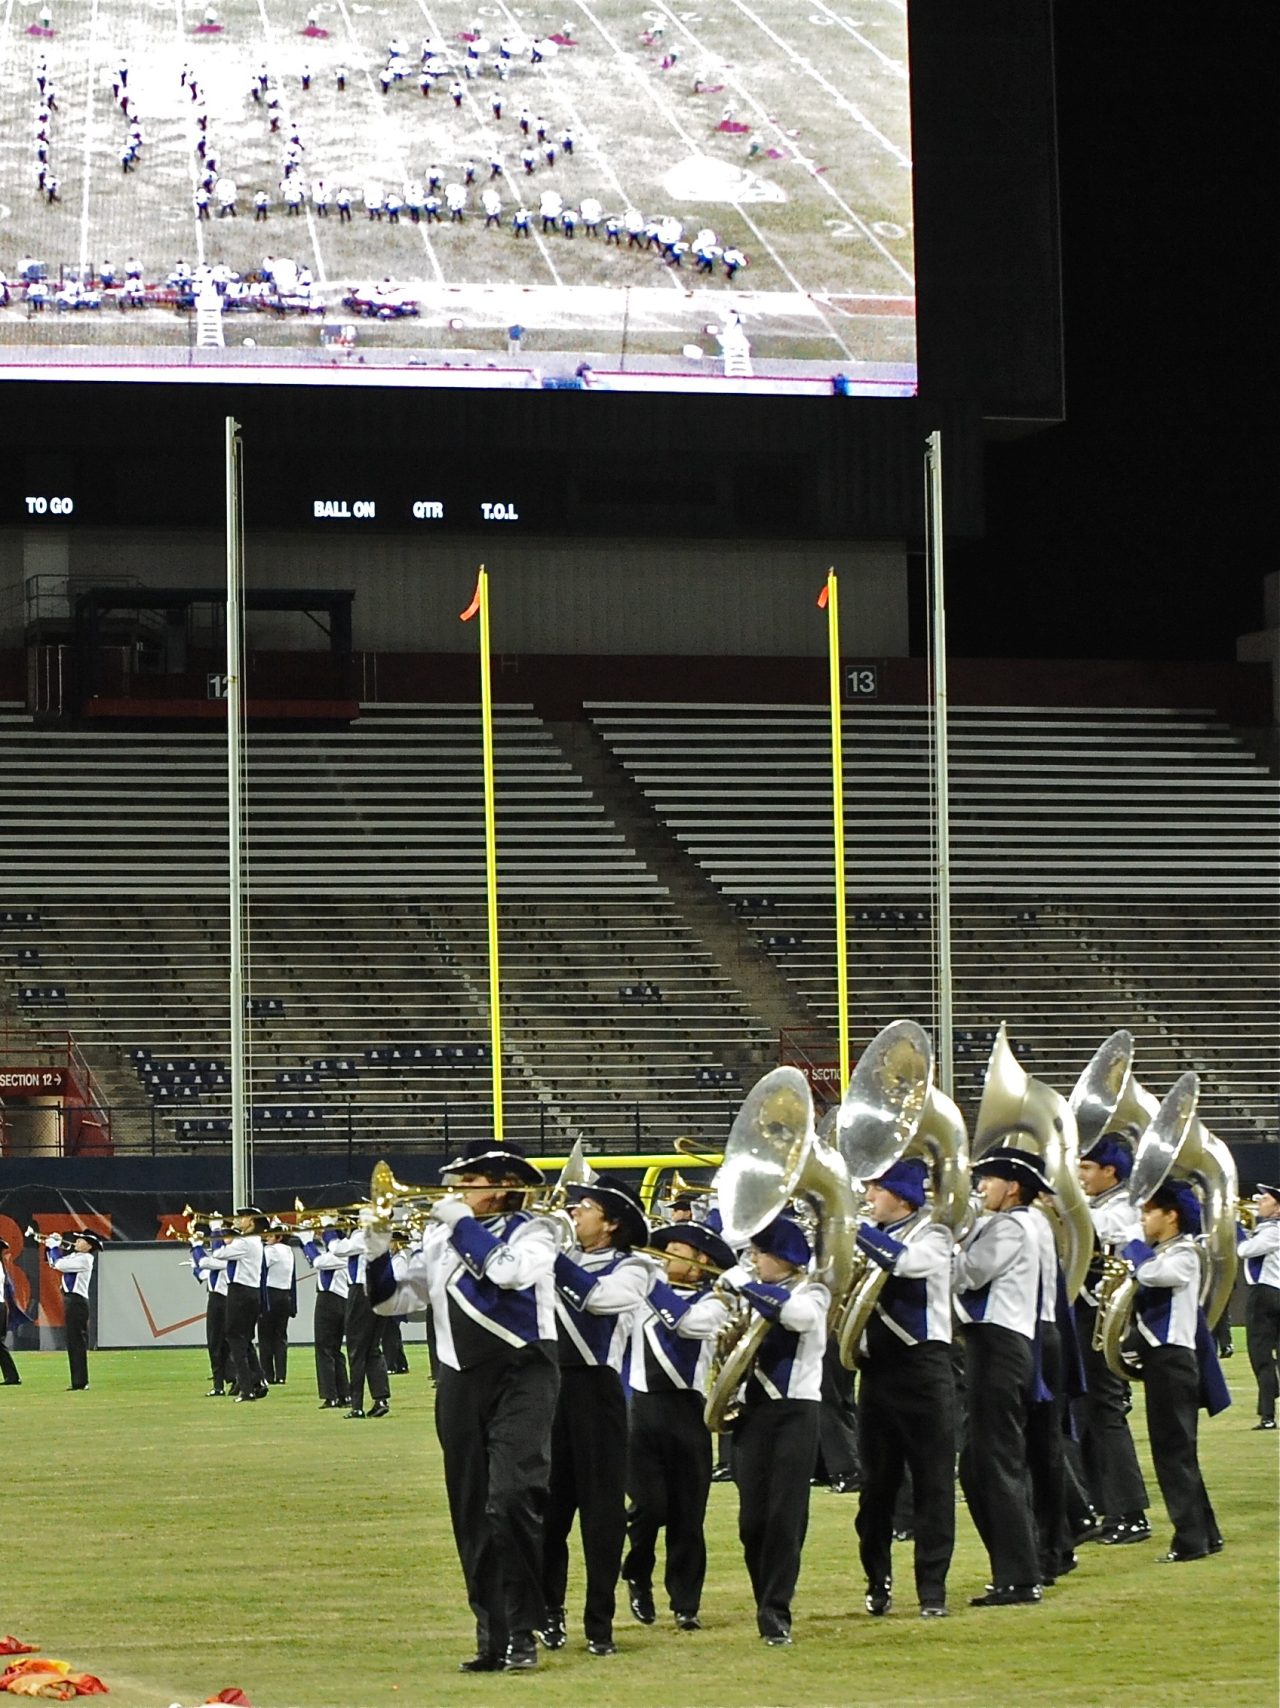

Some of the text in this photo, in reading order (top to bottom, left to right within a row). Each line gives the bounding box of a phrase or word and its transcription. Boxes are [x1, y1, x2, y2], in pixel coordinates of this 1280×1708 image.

[25, 497, 74, 514] TO GO
[313, 501, 376, 518] BALL ON
[412, 502, 444, 519] QTR
[481, 503, 519, 520] T.O.L
[848, 671, 875, 693] 13
[0, 1073, 40, 1087] SECTION
[42, 1073, 53, 1087] 12
